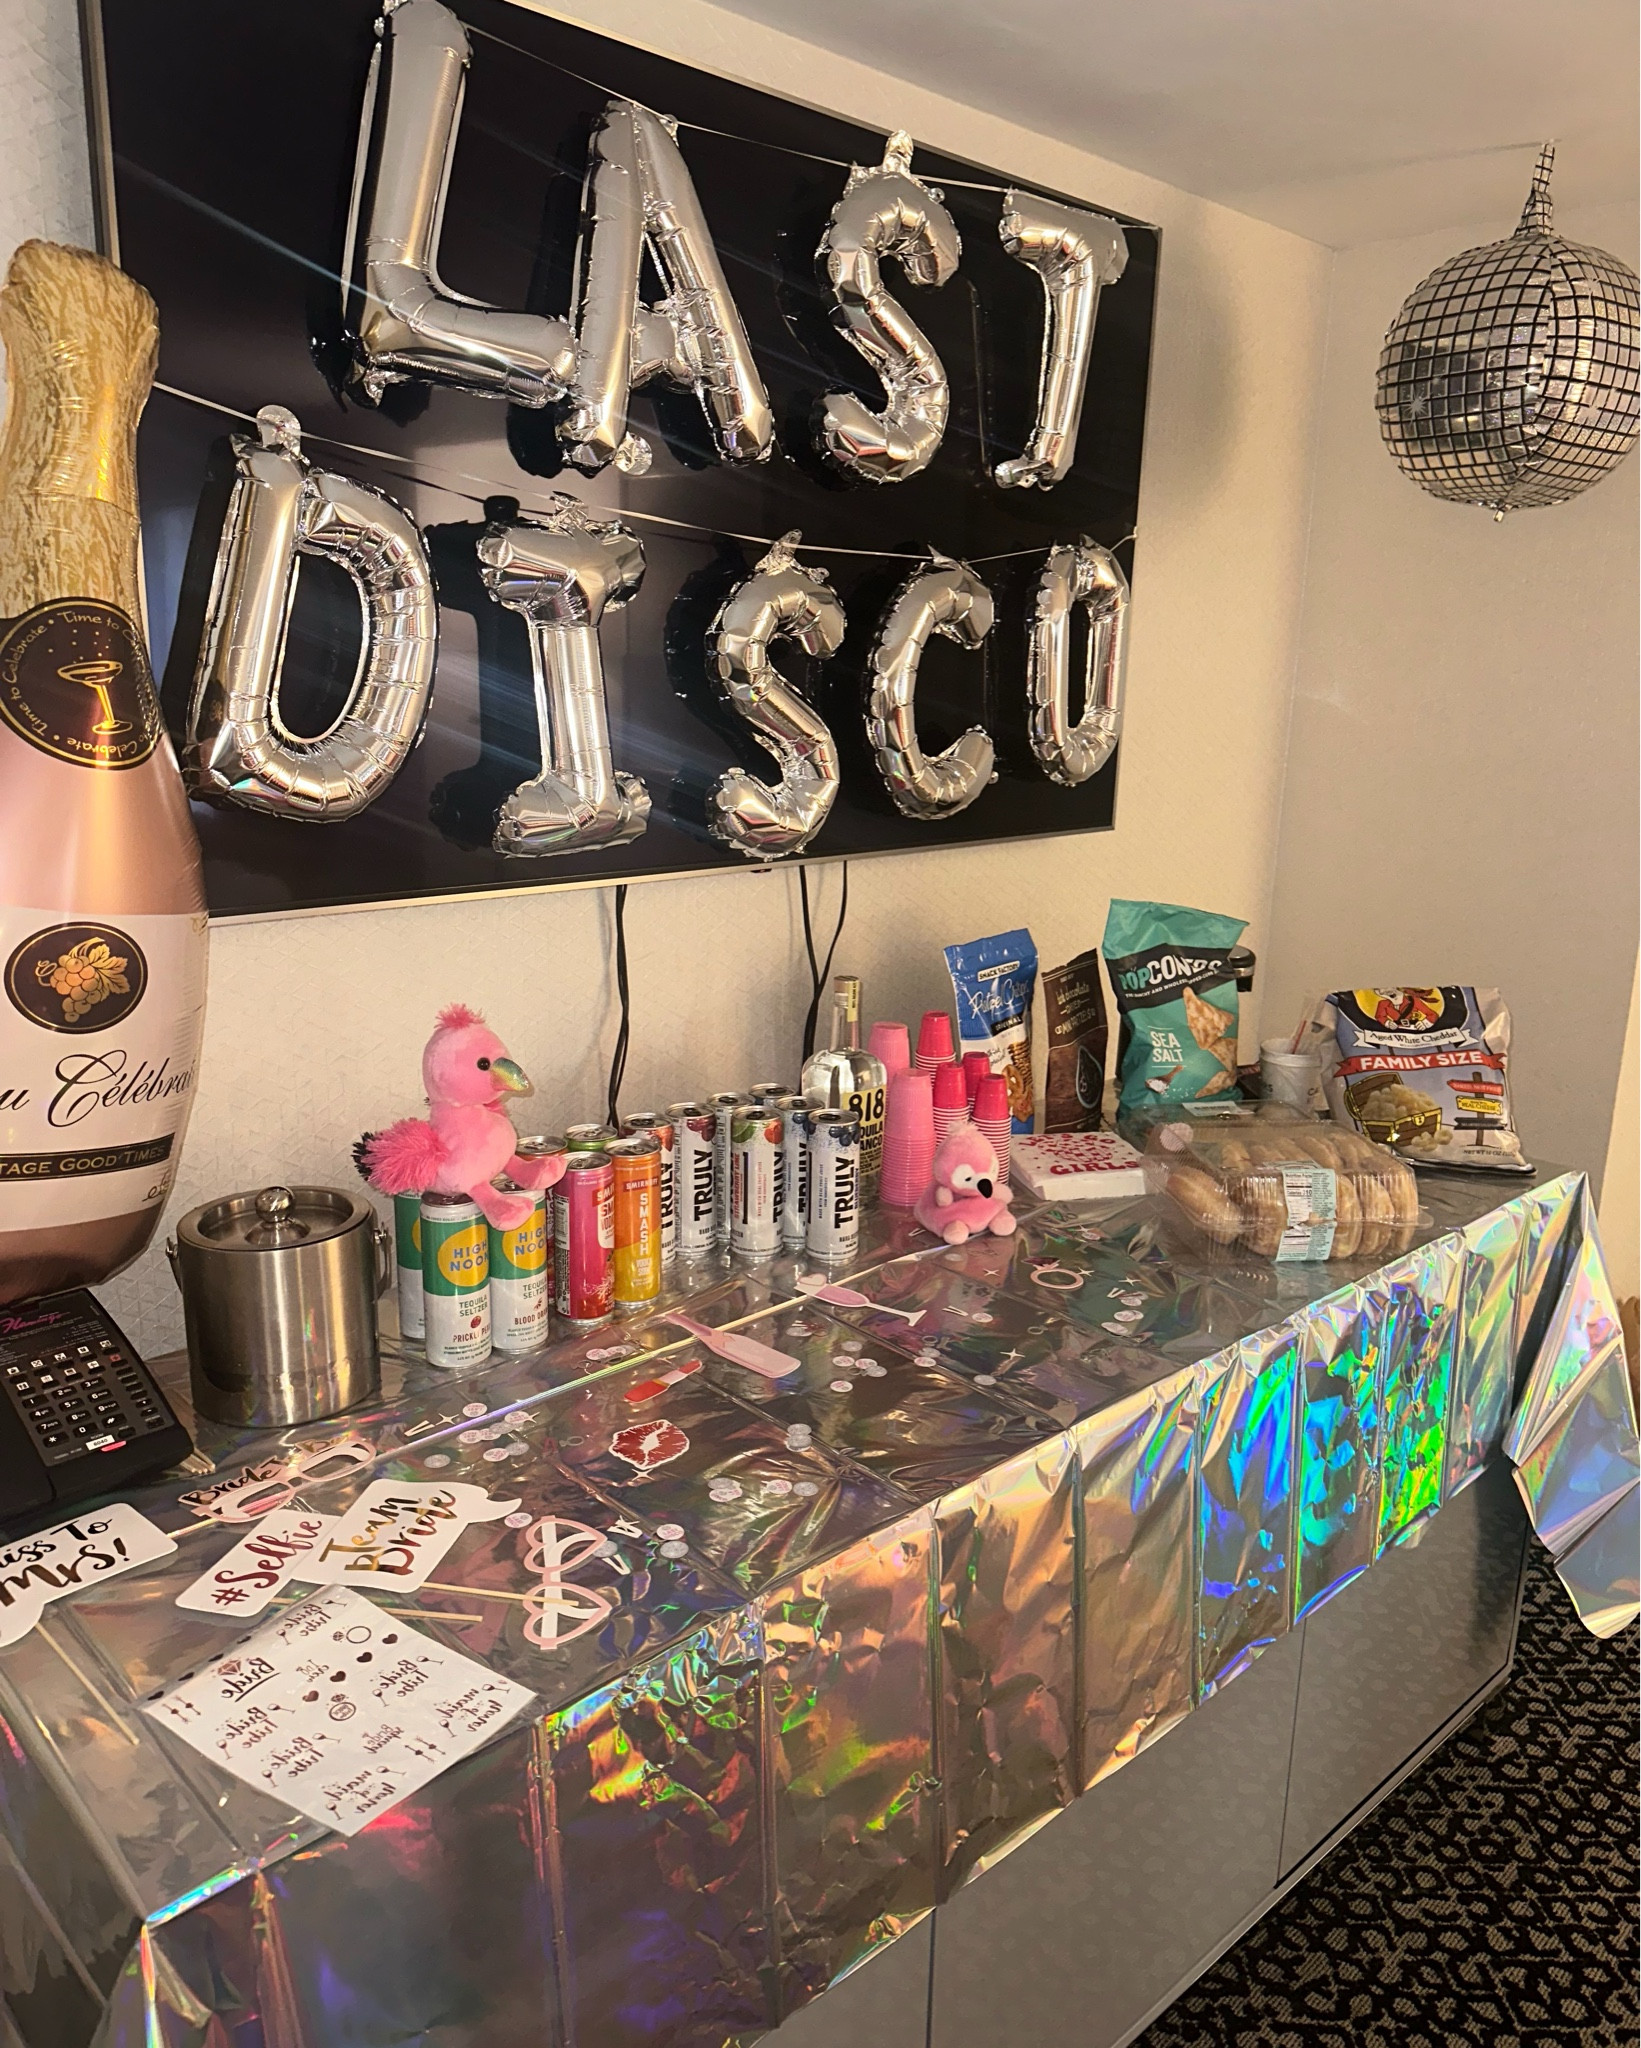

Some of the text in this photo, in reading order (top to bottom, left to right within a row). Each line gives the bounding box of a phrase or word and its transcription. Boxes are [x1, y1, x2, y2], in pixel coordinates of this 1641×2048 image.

[343, 0, 1128, 490] LAST
[57, 610, 120, 631] Time to
[185, 428, 1130, 862] DISCO
[2, 624, 48, 737] Time to Celebrate
[66, 737, 138, 758] Celebrate
[1149, 1030, 1181, 1048] SEA
[1370, 1031, 1457, 1044] Aged White Cheddar
[1152, 1048, 1184, 1063] SALT
[1360, 1050, 1483, 1070] FAMILY SIZE
[848, 1088, 884, 1122] 818
[860, 1120, 883, 1139] QUILA
[860, 1134, 883, 1152] ANCO
[0, 1145, 166, 1176] TAGE GOOD TIMES
[1049, 1160, 1140, 1176] GIRLS
[693, 1149, 713, 1222] TRULY
[834, 1156, 855, 1229] TRULY
[639, 1192, 649, 1256] SMASH
[514, 1239, 546, 1256] NOO
[458, 1294, 488, 1310] TEQUILA
[514, 1314, 535, 1326] BLOOD
[182, 1466, 282, 1506] Bride
[50, 1519, 114, 1541] To
[318, 1497, 422, 1563] Team
[344, 1489, 458, 1576] Bride
[211, 1519, 323, 1606] #Selfie
